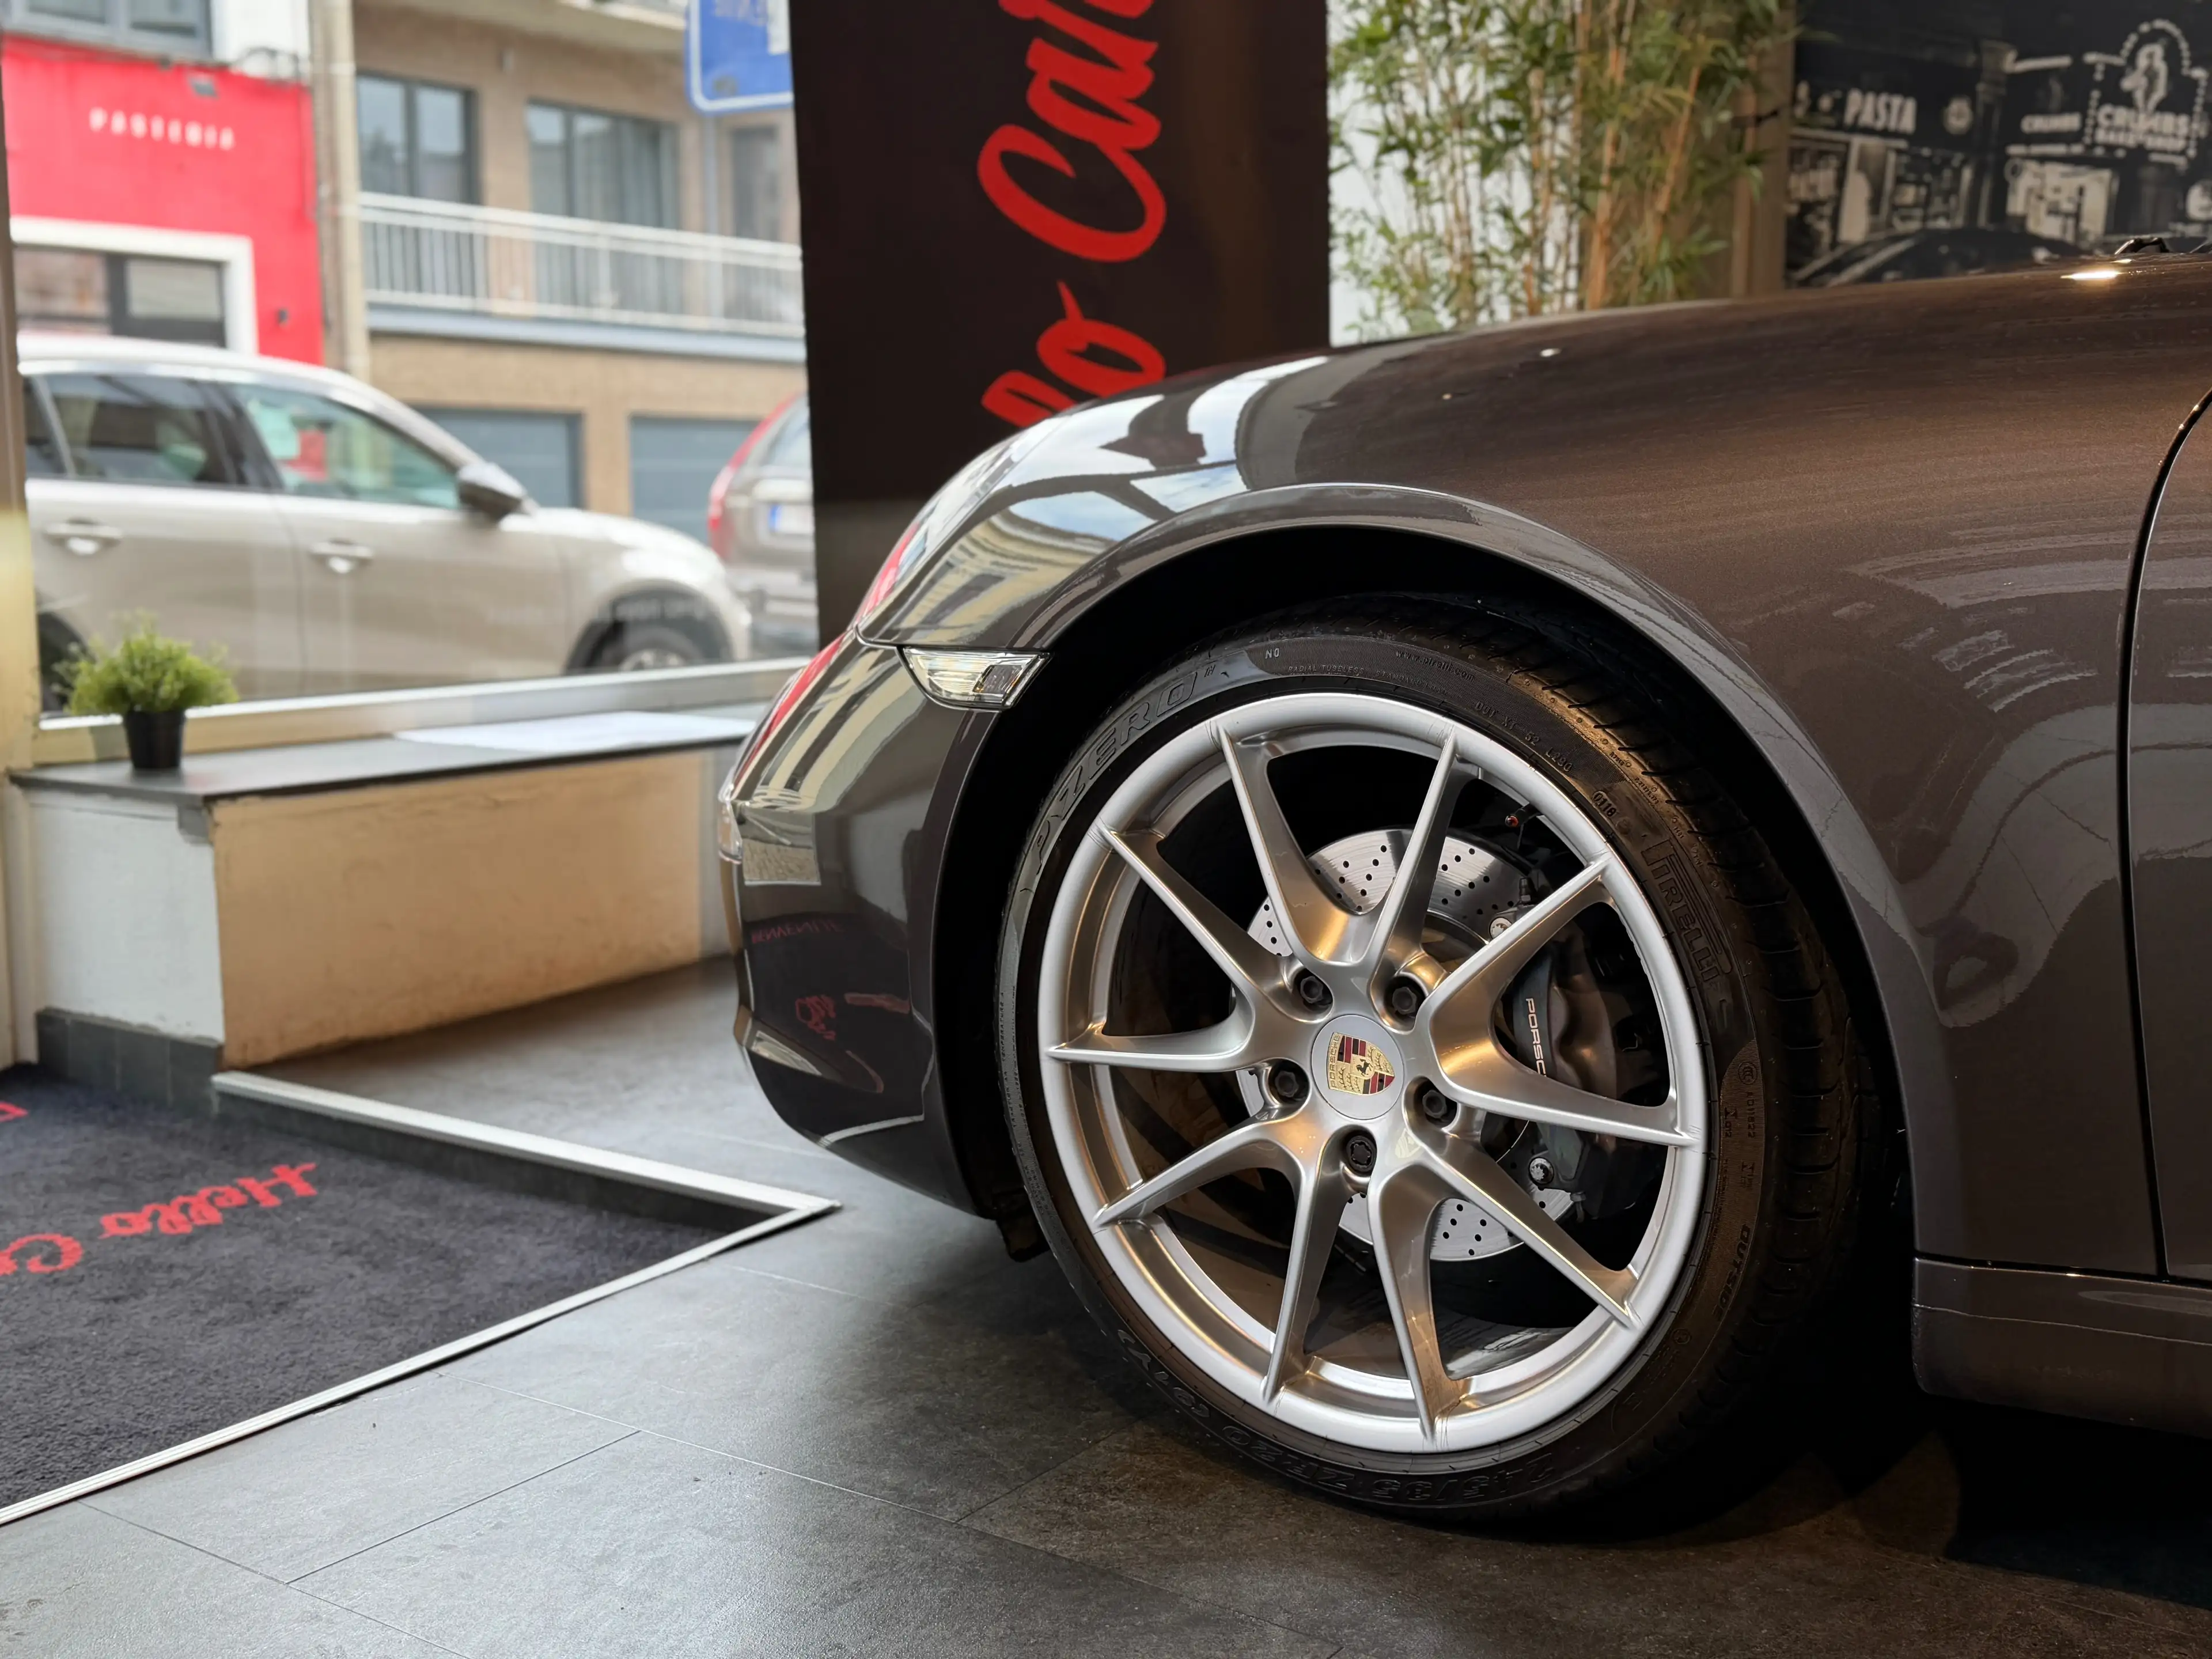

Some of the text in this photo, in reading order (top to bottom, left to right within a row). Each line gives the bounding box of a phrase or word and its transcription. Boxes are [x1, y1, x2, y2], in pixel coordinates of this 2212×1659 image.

[1844, 87, 1917, 135] PASTA
[1287, 664, 1317, 673] RADIAL
[1321, 664, 1365, 675] TUBELESS
[1641, 839, 1732, 983] PIRELLI
[1328, 1034, 1342, 1089] PORSCHE
[1526, 998, 1547, 1077] PORSC
[99, 1162, 317, 1240] Hello
[1712, 1223, 1751, 1321] OUTSIDE
